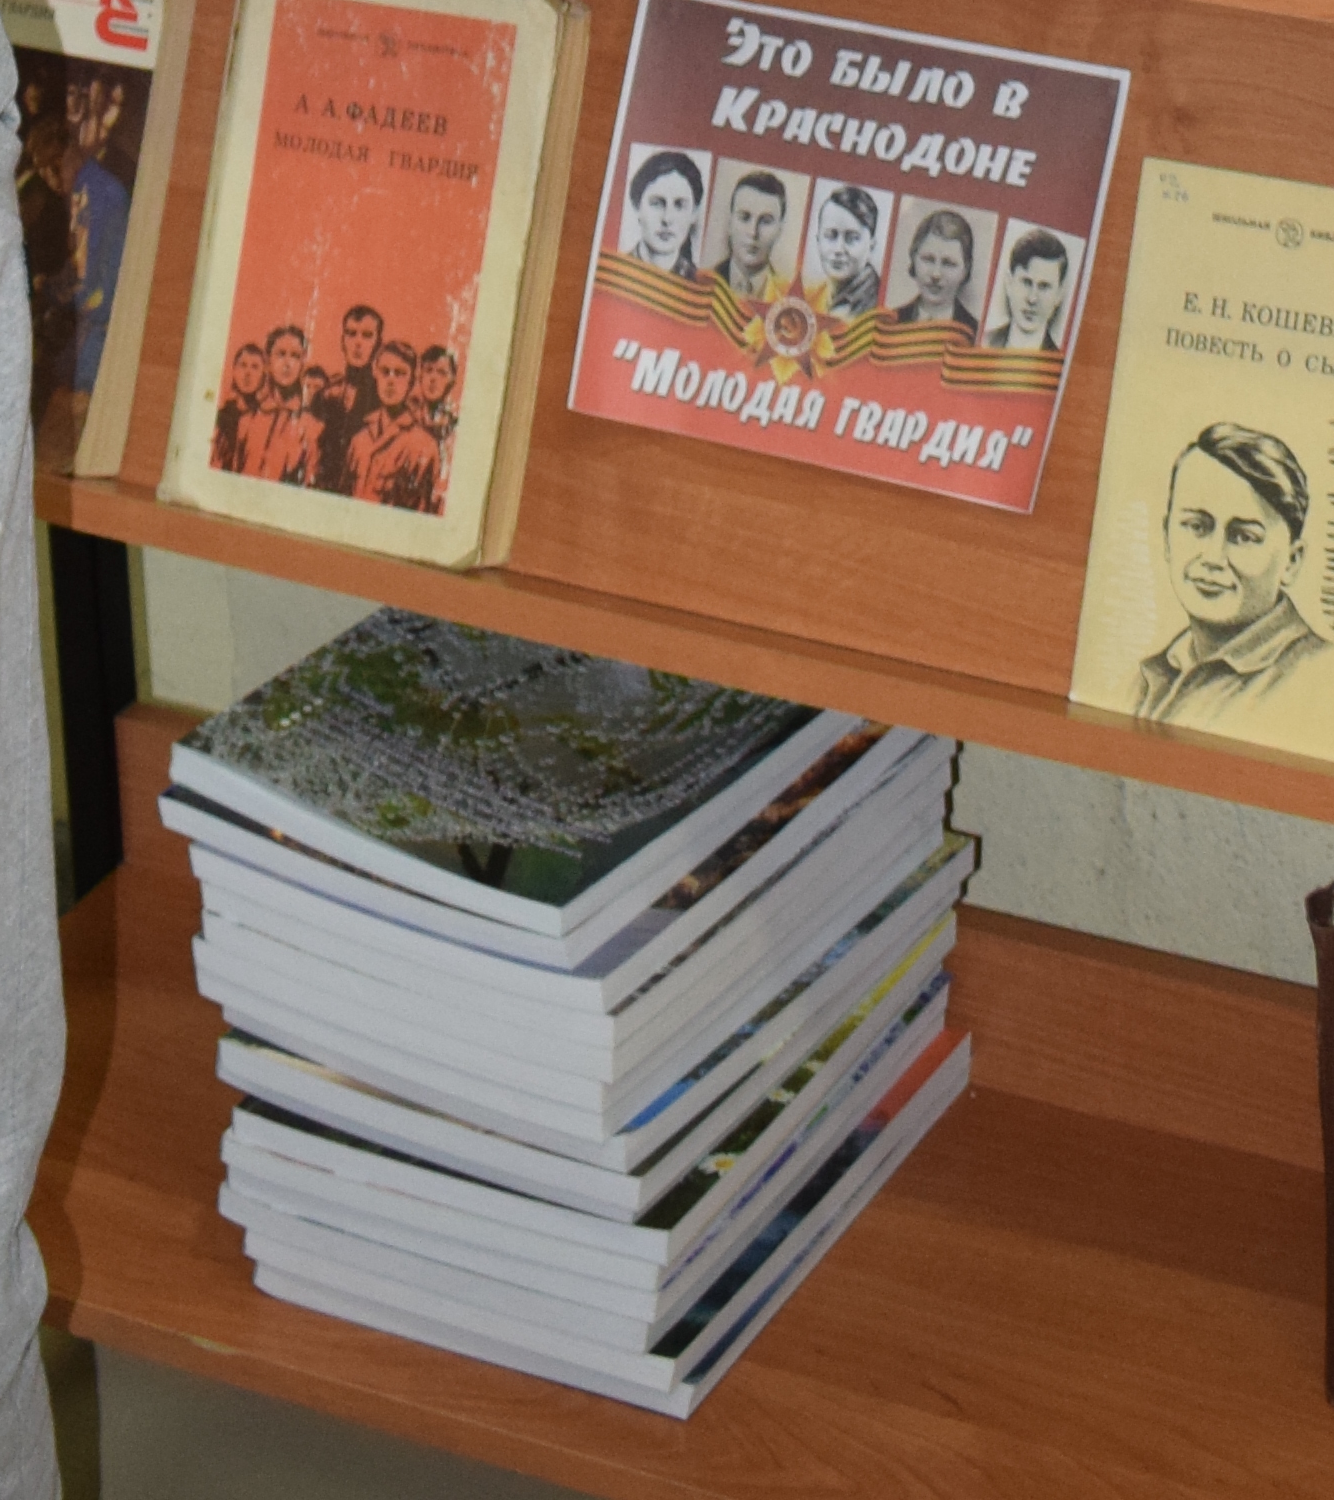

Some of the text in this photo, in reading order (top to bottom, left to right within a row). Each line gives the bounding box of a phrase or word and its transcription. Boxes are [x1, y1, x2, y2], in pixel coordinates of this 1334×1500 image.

[345, 100, 448, 137] ФАДЕЕВ
[273, 131, 479, 182] МОЛОДАЯ ГВАРДИЯ
[1183, 291, 1203, 314] Е.
[1211, 296, 1232, 320] Н.
[1165, 326, 1265, 363] ПОВЕСТЬ
[1276, 347, 1292, 368] О
